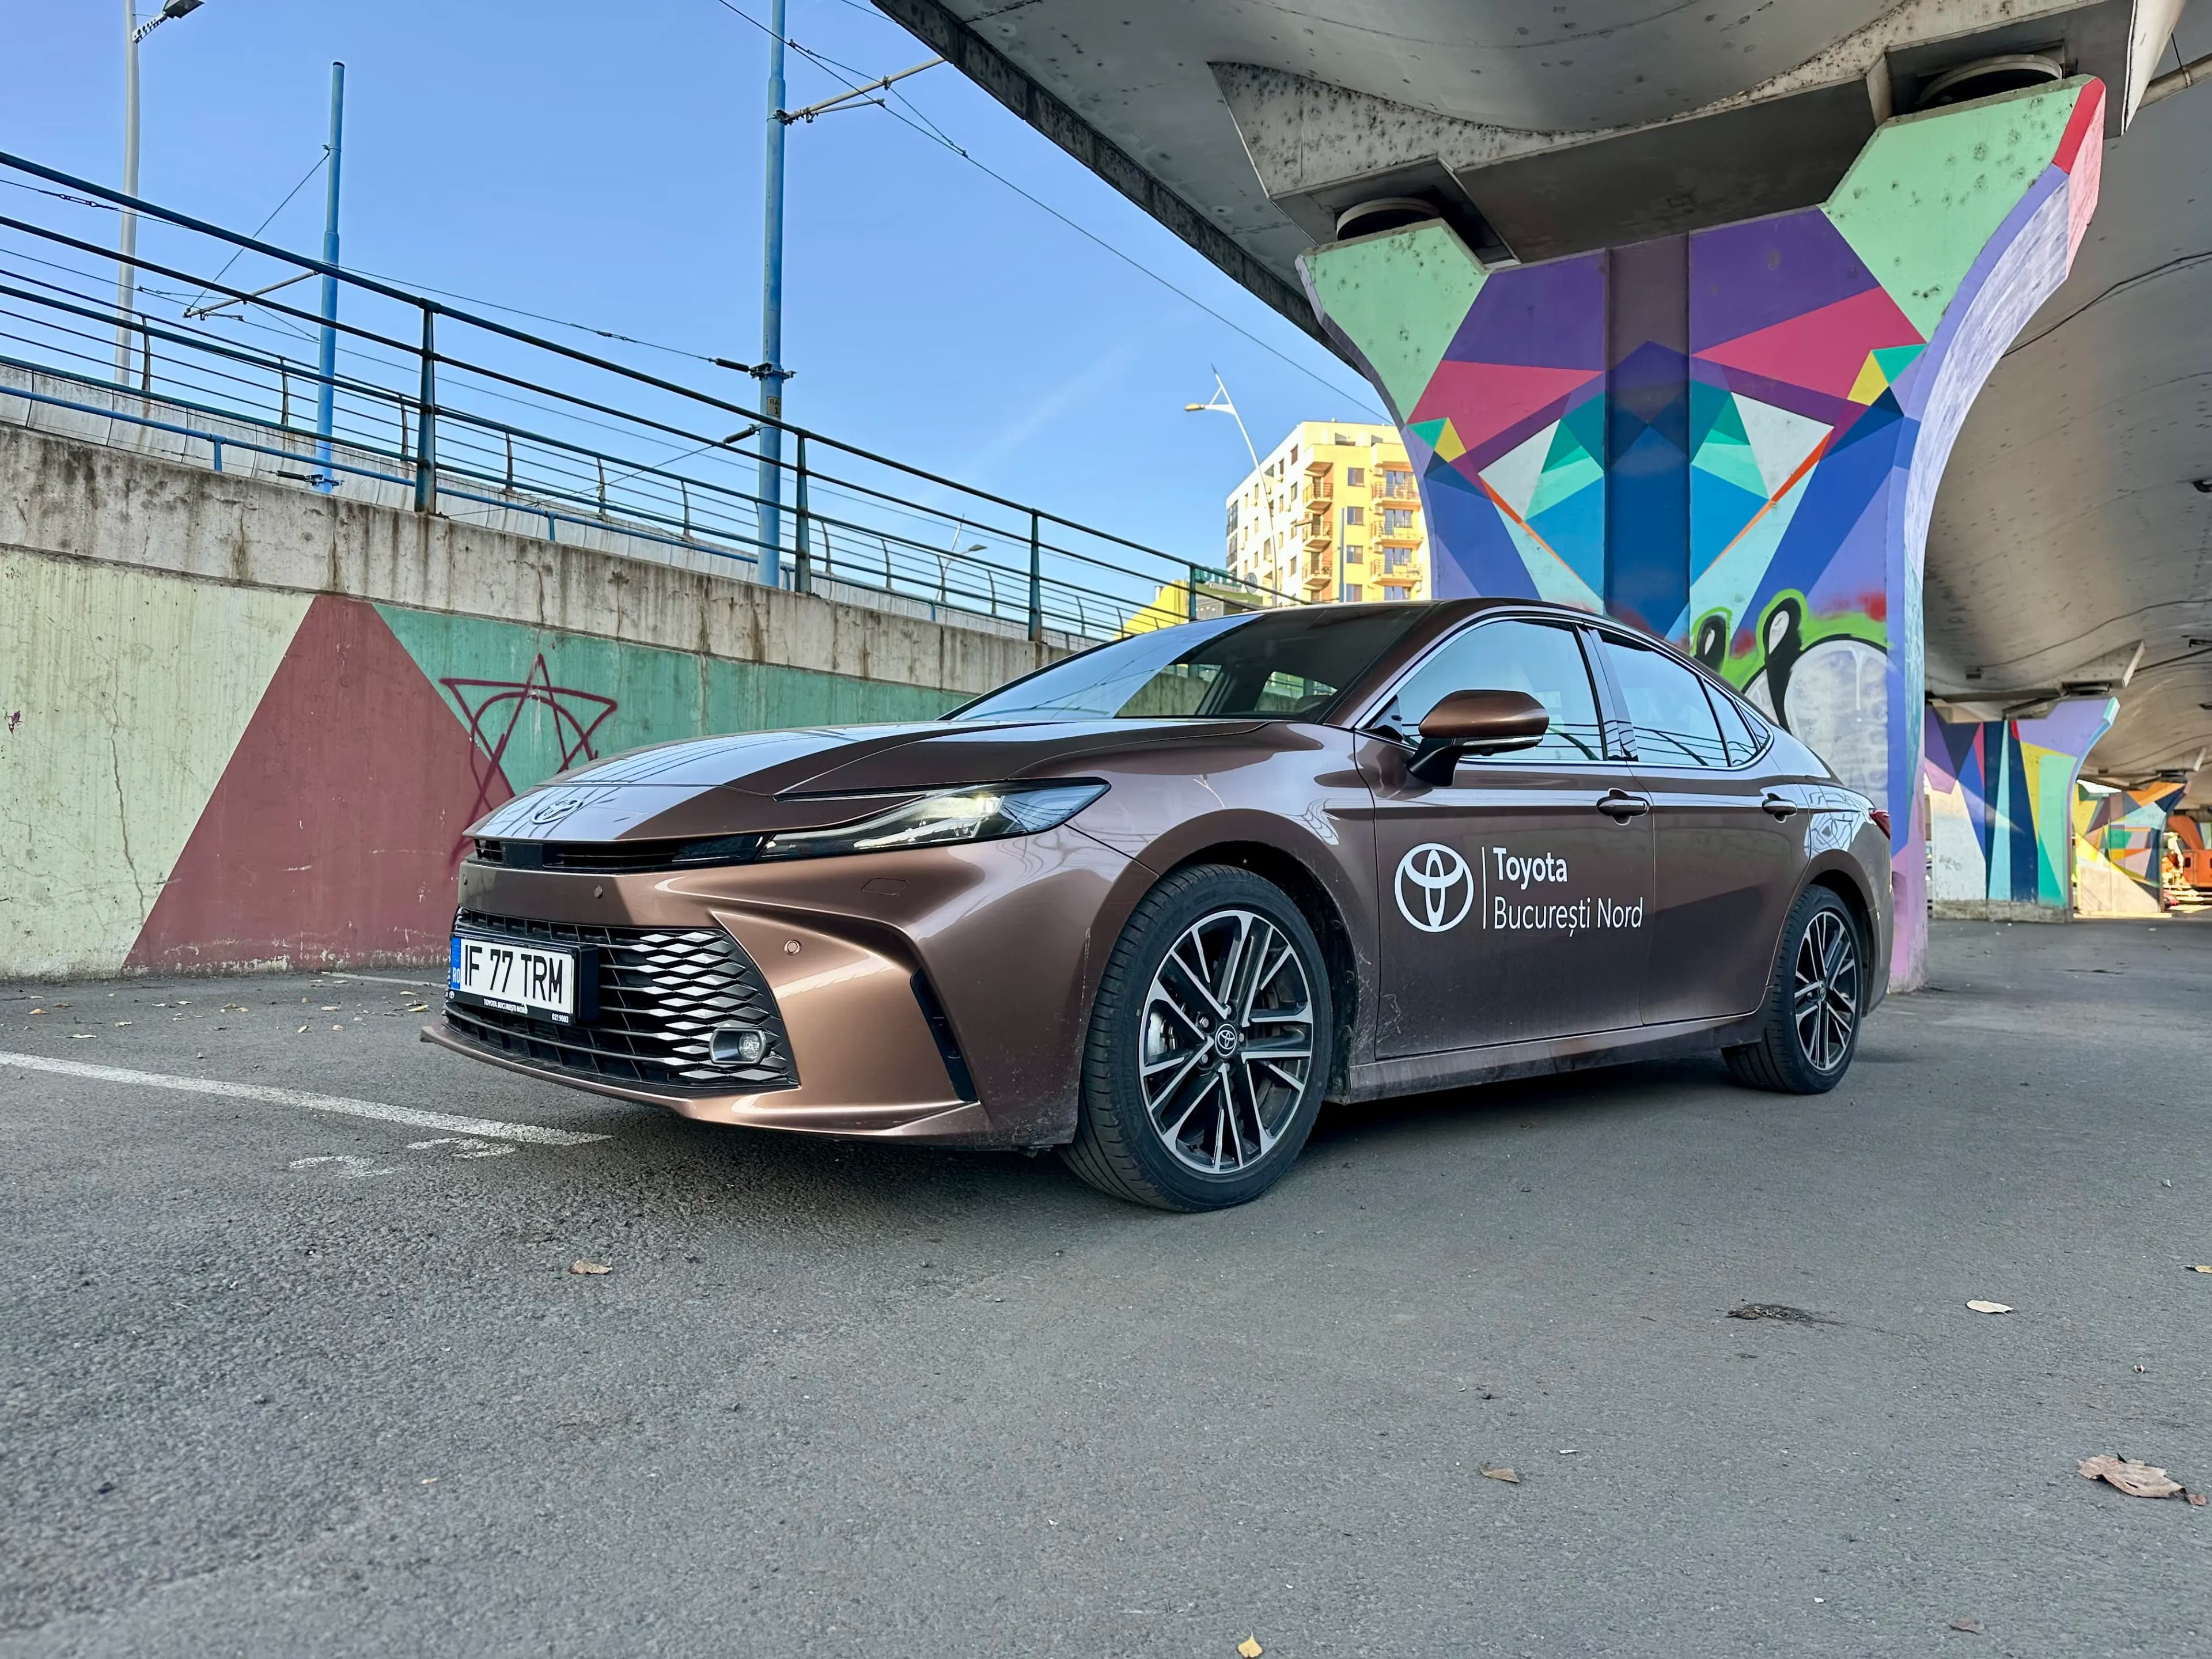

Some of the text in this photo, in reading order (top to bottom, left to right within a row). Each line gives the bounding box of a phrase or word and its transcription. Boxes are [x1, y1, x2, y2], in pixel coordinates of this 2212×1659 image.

[1493, 847, 1567, 890] Toyota
[1494, 896, 1643, 937] București Nord
[453, 967, 460, 983] RO
[465, 945, 563, 1004] IF 77 TRM
[483, 998, 497, 1008] TOYOTA
